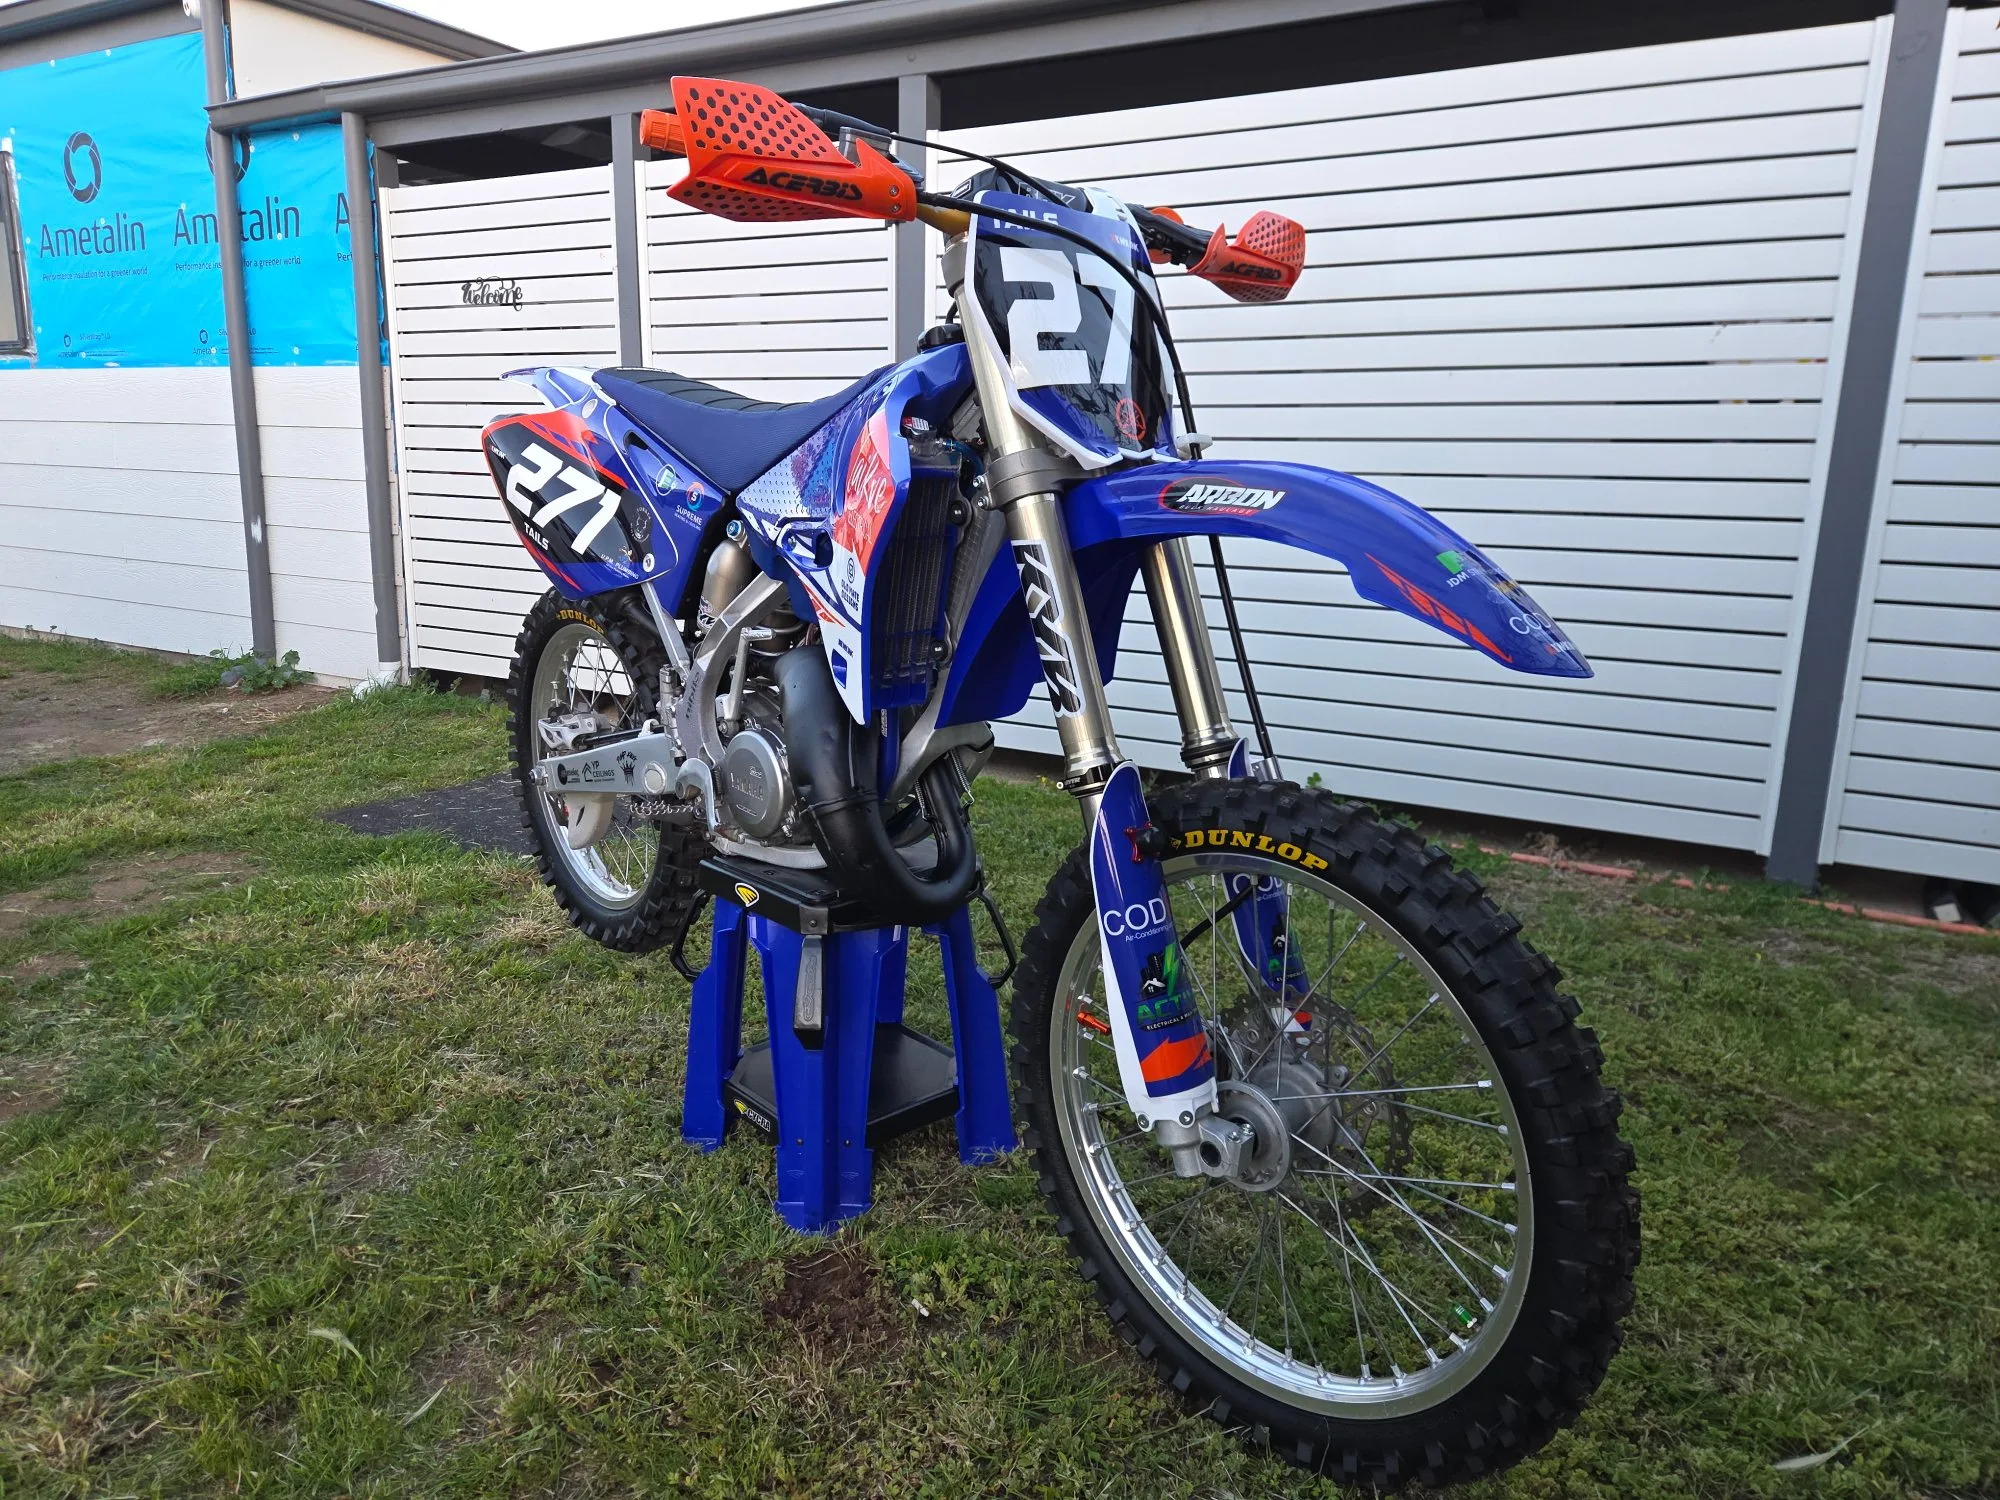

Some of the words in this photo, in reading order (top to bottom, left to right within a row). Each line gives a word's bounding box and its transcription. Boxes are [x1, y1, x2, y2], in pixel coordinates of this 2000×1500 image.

[40, 212, 146, 258] Ametalin
[174, 196, 300, 247] Amtalin
[461, 277, 522, 311] Welcome
[506, 442, 621, 555] 271
[676, 505, 703, 526] SUPREME
[524, 521, 549, 551] TAILS
[615, 562, 639, 580] PLUMBING
[560, 609, 605, 634] DUNLOP
[592, 769, 615, 778] CEILINGS
[1185, 829, 1329, 870] DUNLOP
[1146, 1015, 1180, 1031] ELECTRICAL
[746, 1108, 771, 1132] CYCRA
